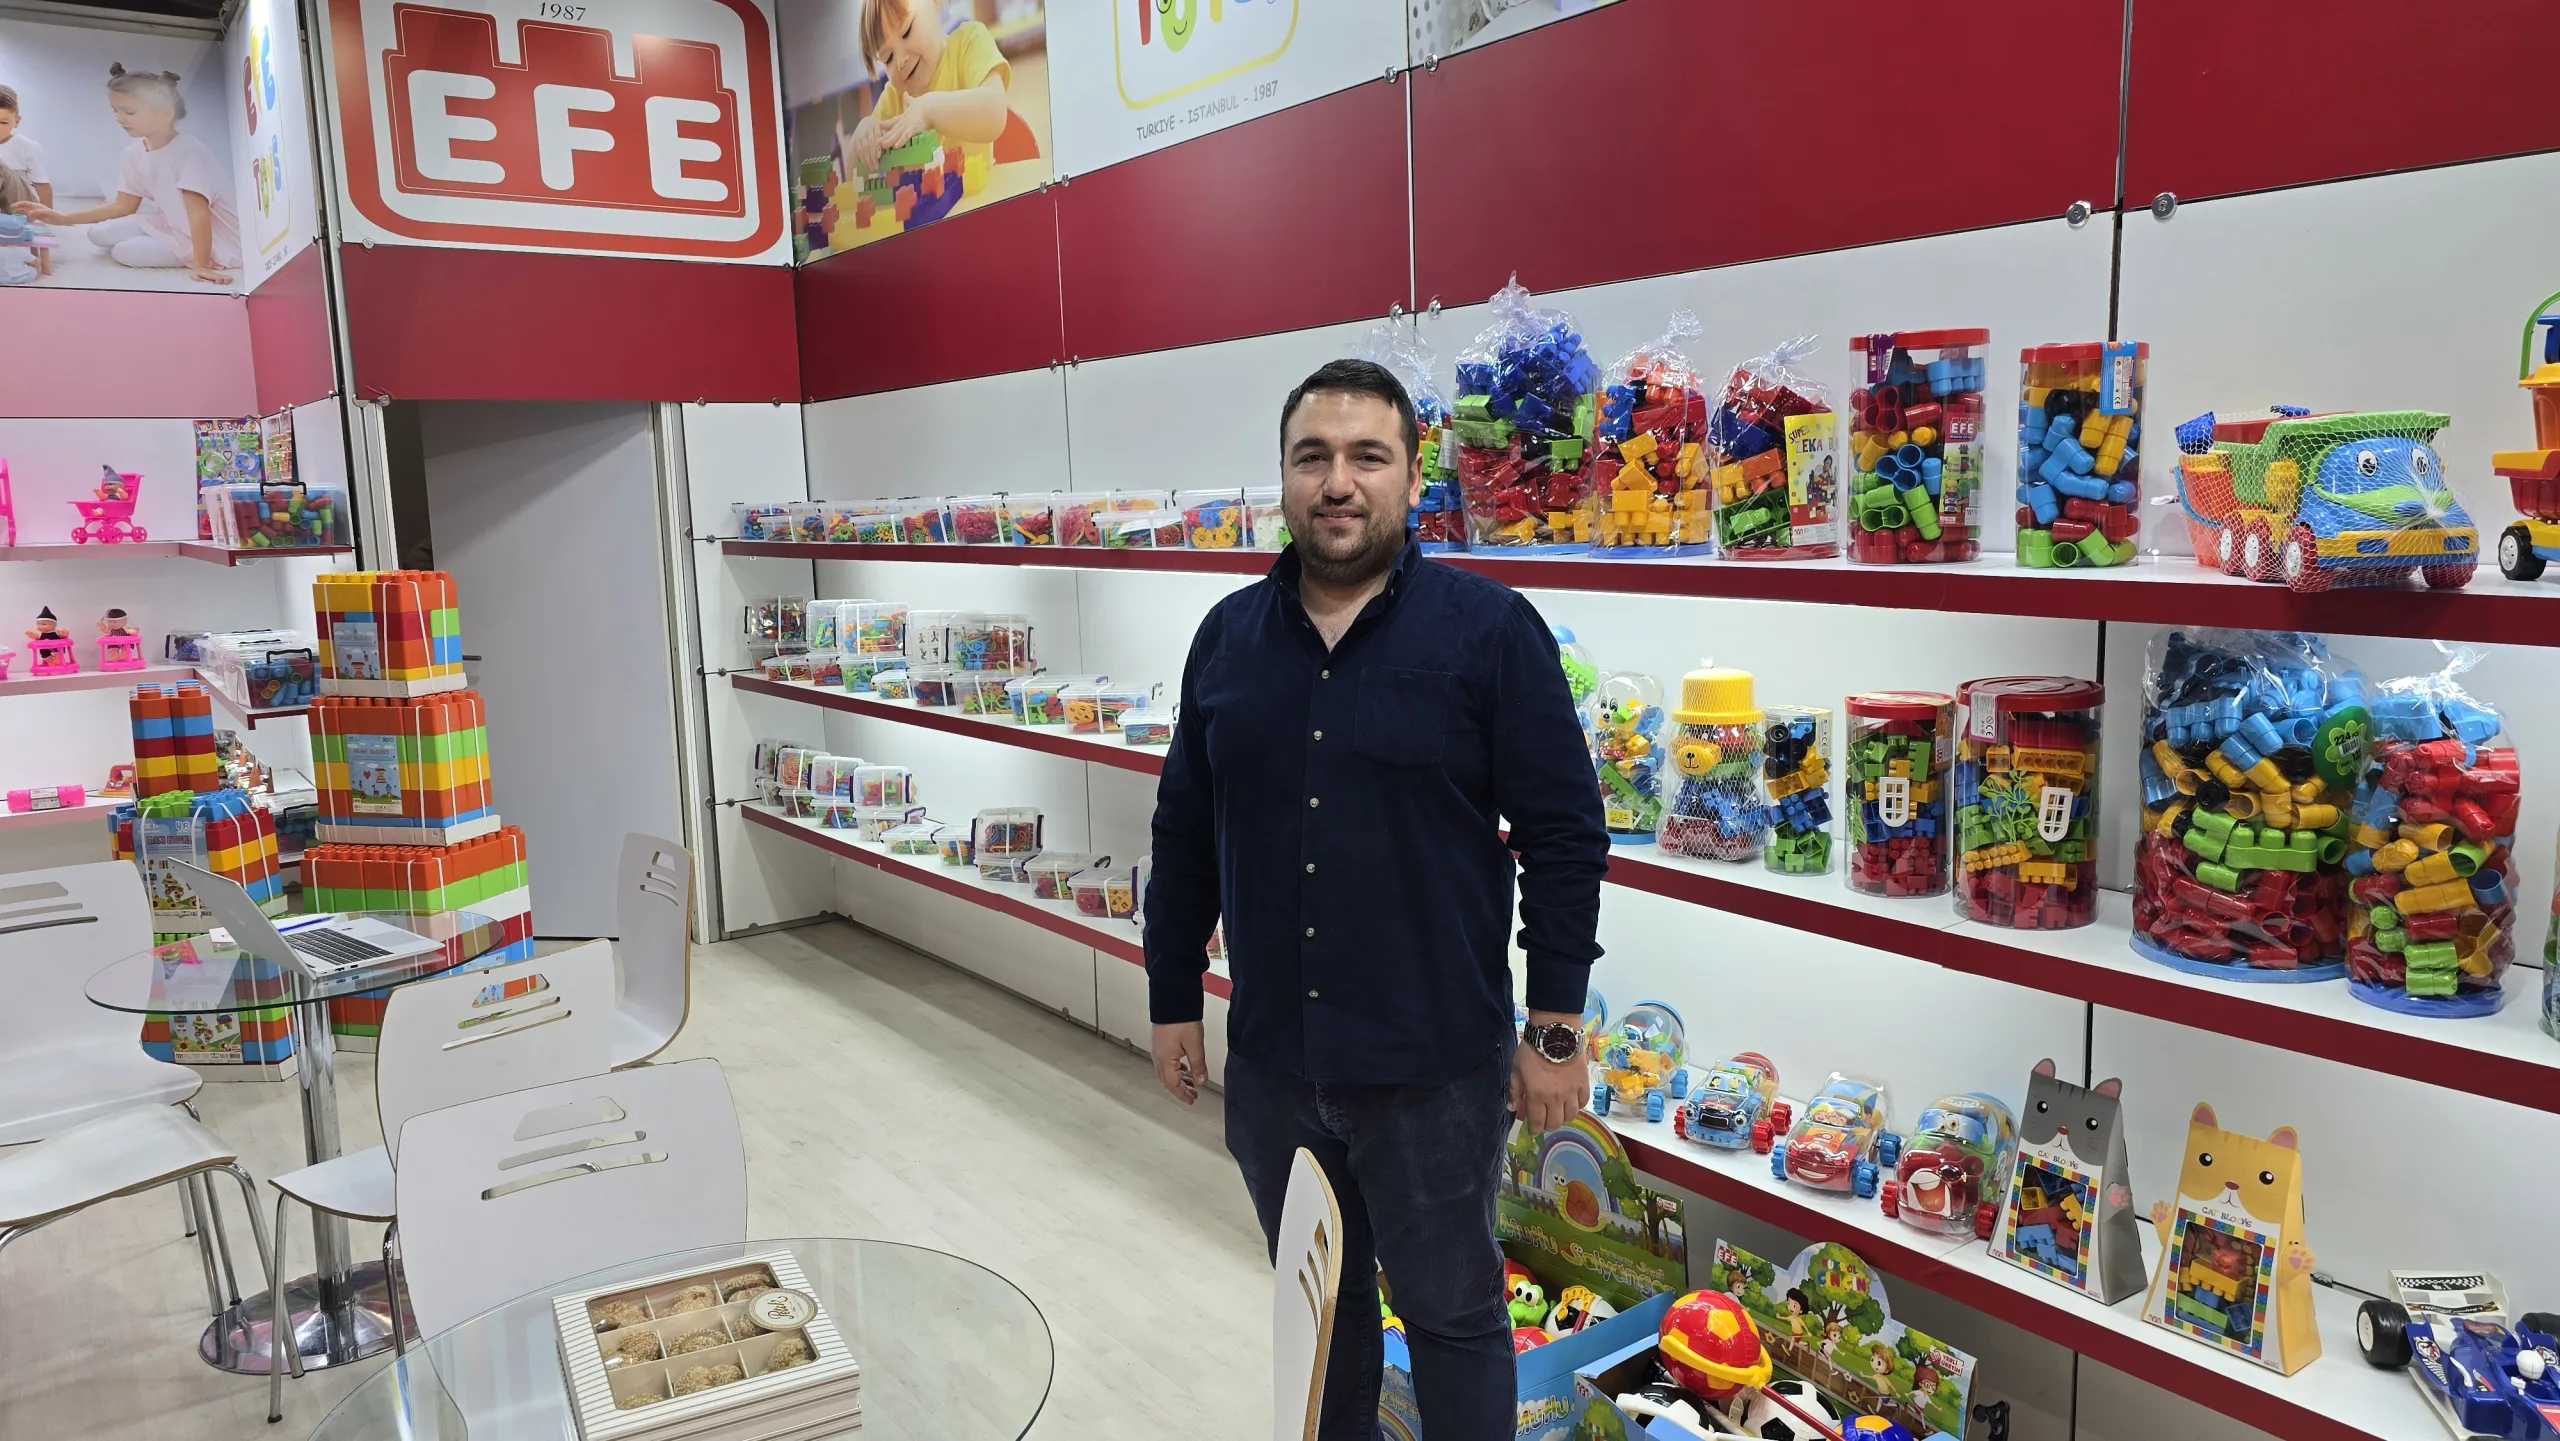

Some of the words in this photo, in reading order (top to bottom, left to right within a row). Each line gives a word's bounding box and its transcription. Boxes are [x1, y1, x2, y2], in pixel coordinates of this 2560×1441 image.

[538, 1, 588, 22] 1987
[243, 25, 276, 137] EFE
[1136, 115, 1176, 140] TURKIYE
[1187, 95, 1239, 124] ISTANBUL
[1253, 80, 1279, 102] 1987
[407, 69, 729, 203] EFE
[253, 134, 282, 219] TOYS
[1950, 422, 1974, 434] EFE
[1795, 438, 1823, 454] ZEKA
[2333, 731, 2351, 746] 224
[175, 820, 191, 833] 48
[145, 835, 166, 845] MAXI
[166, 835, 193, 845] BLOCKS
[2220, 1212, 2253, 1228] BLOCKS
[1717, 1249, 1739, 1267] EFE
[1576, 1384, 1592, 1400] EFE
